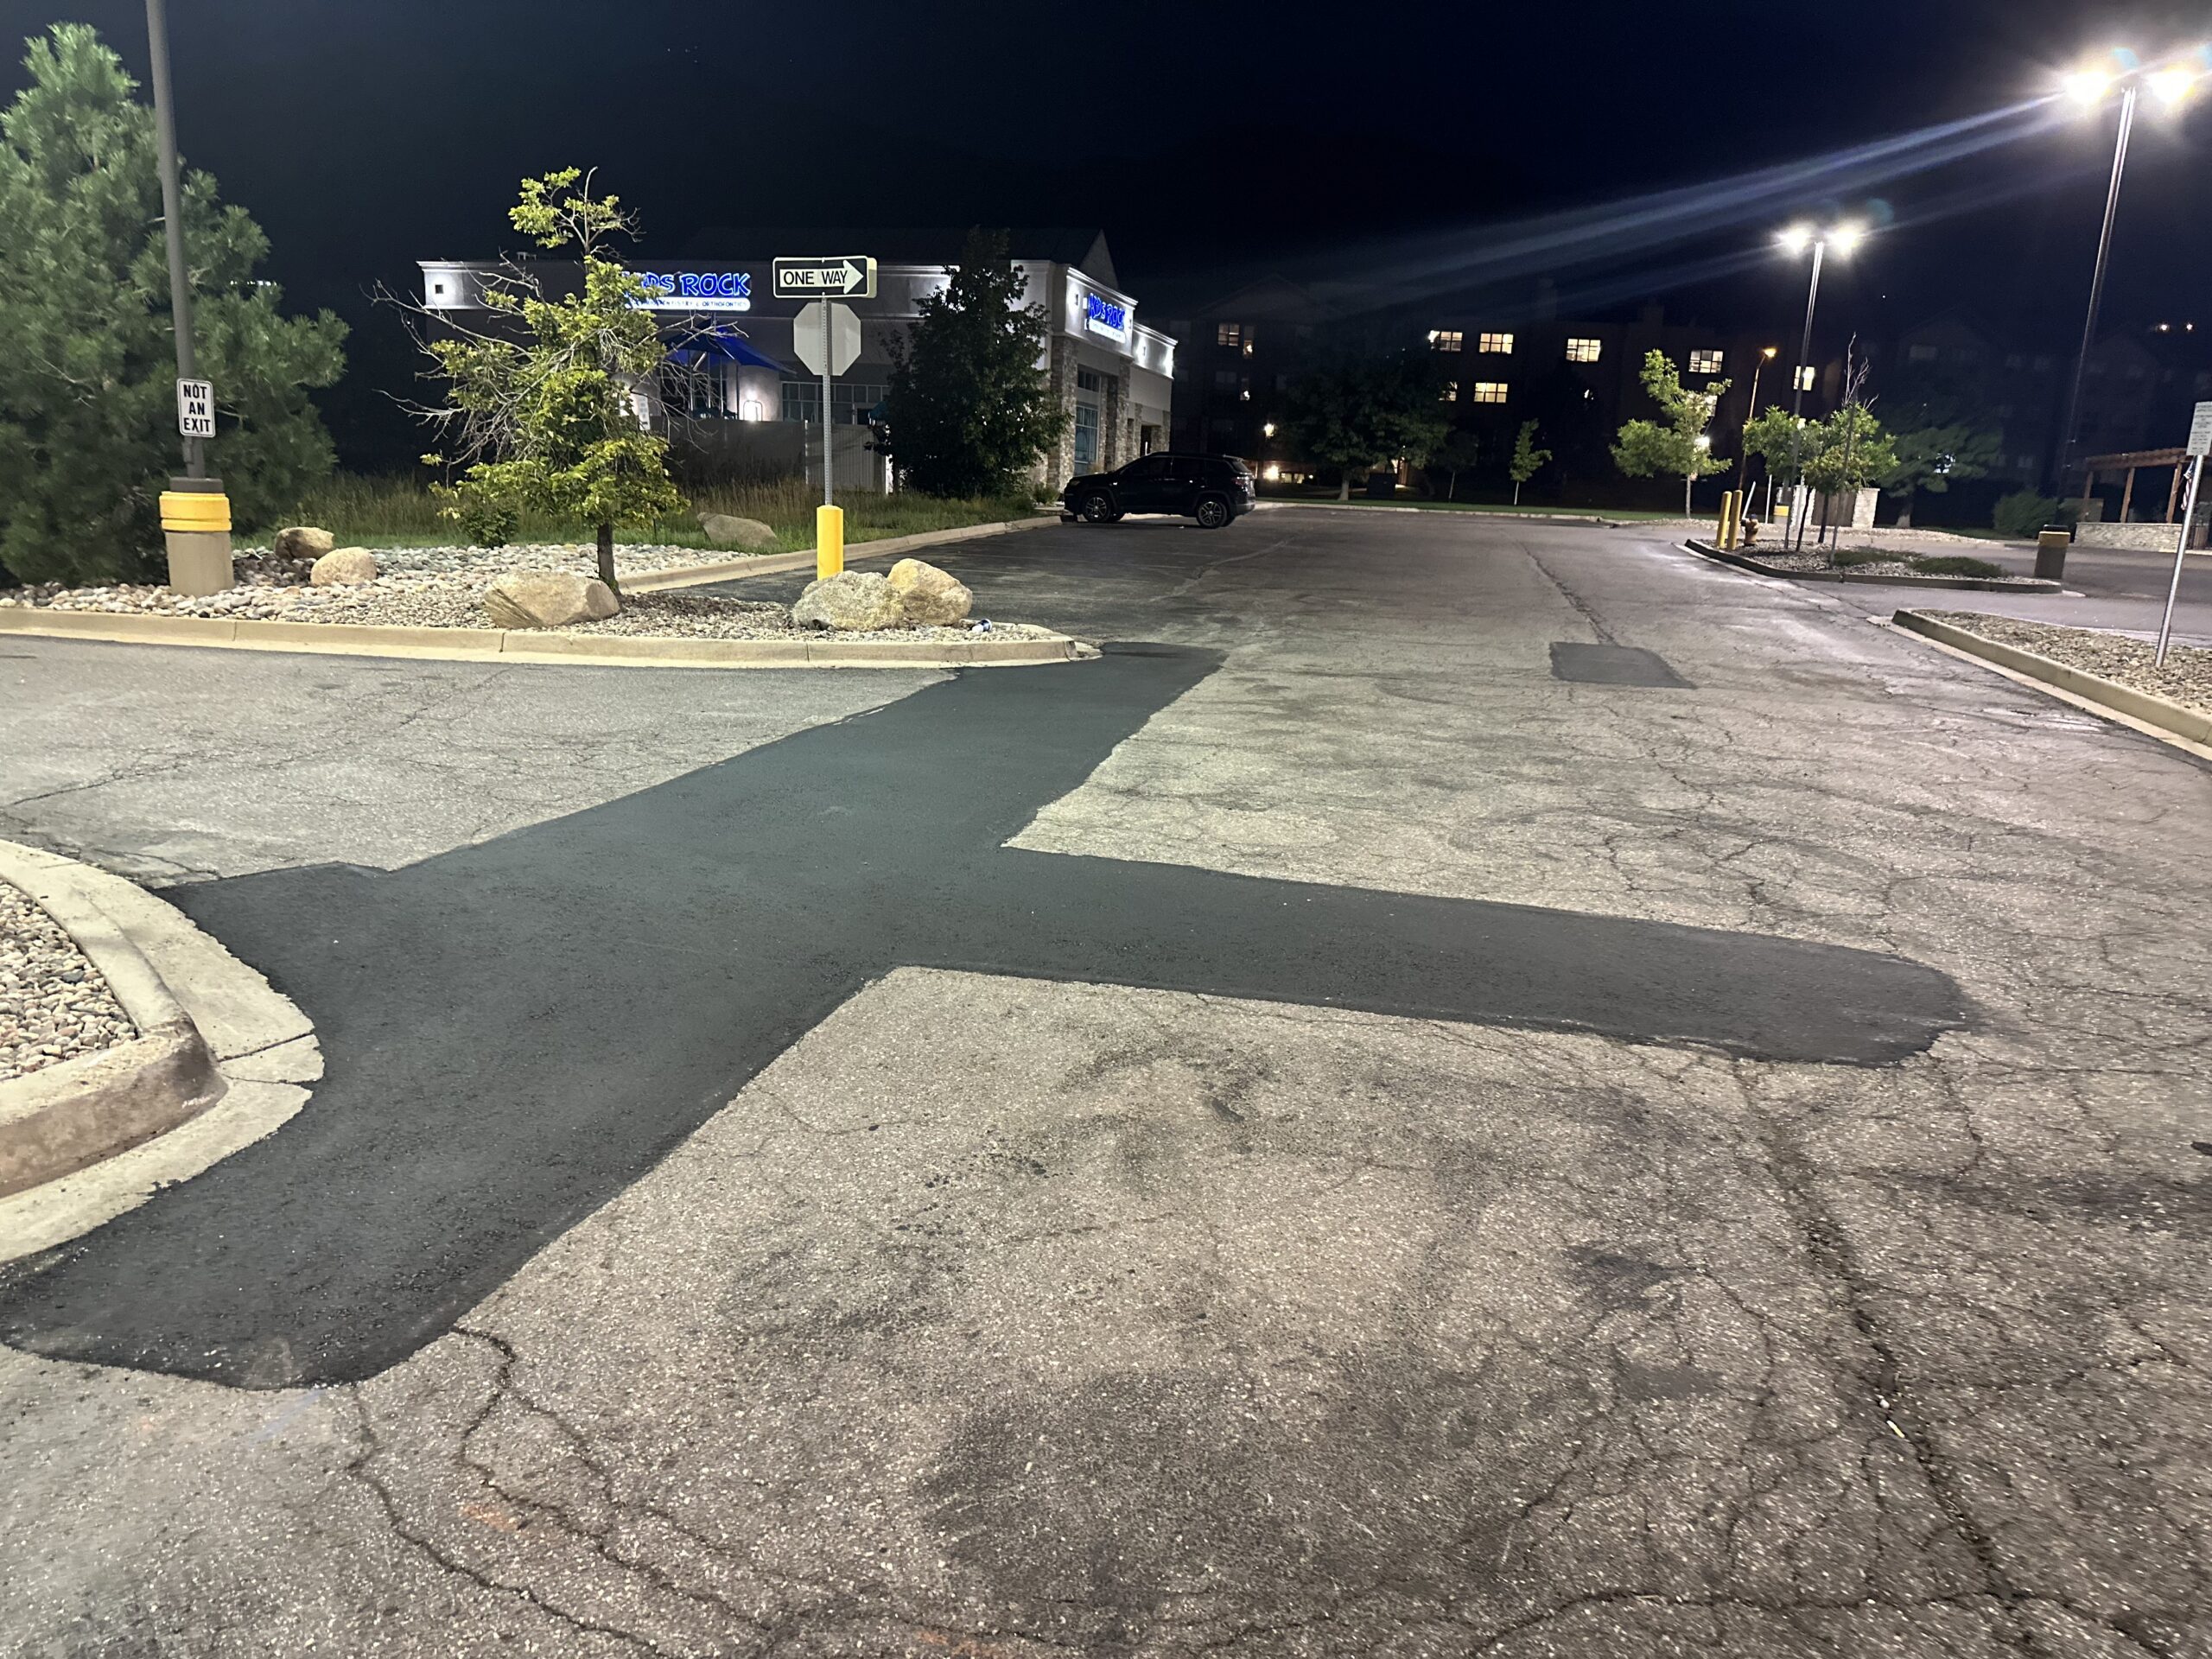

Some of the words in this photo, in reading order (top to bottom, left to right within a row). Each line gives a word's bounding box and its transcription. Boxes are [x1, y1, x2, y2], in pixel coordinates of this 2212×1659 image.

[621, 270, 676, 296] DS
[679, 272, 751, 296] ROCK
[783, 270, 815, 285] ONE
[821, 270, 848, 285] WAY
[183, 384, 207, 398] NOT
[189, 402, 205, 415] AN
[183, 417, 211, 432] EXIT
